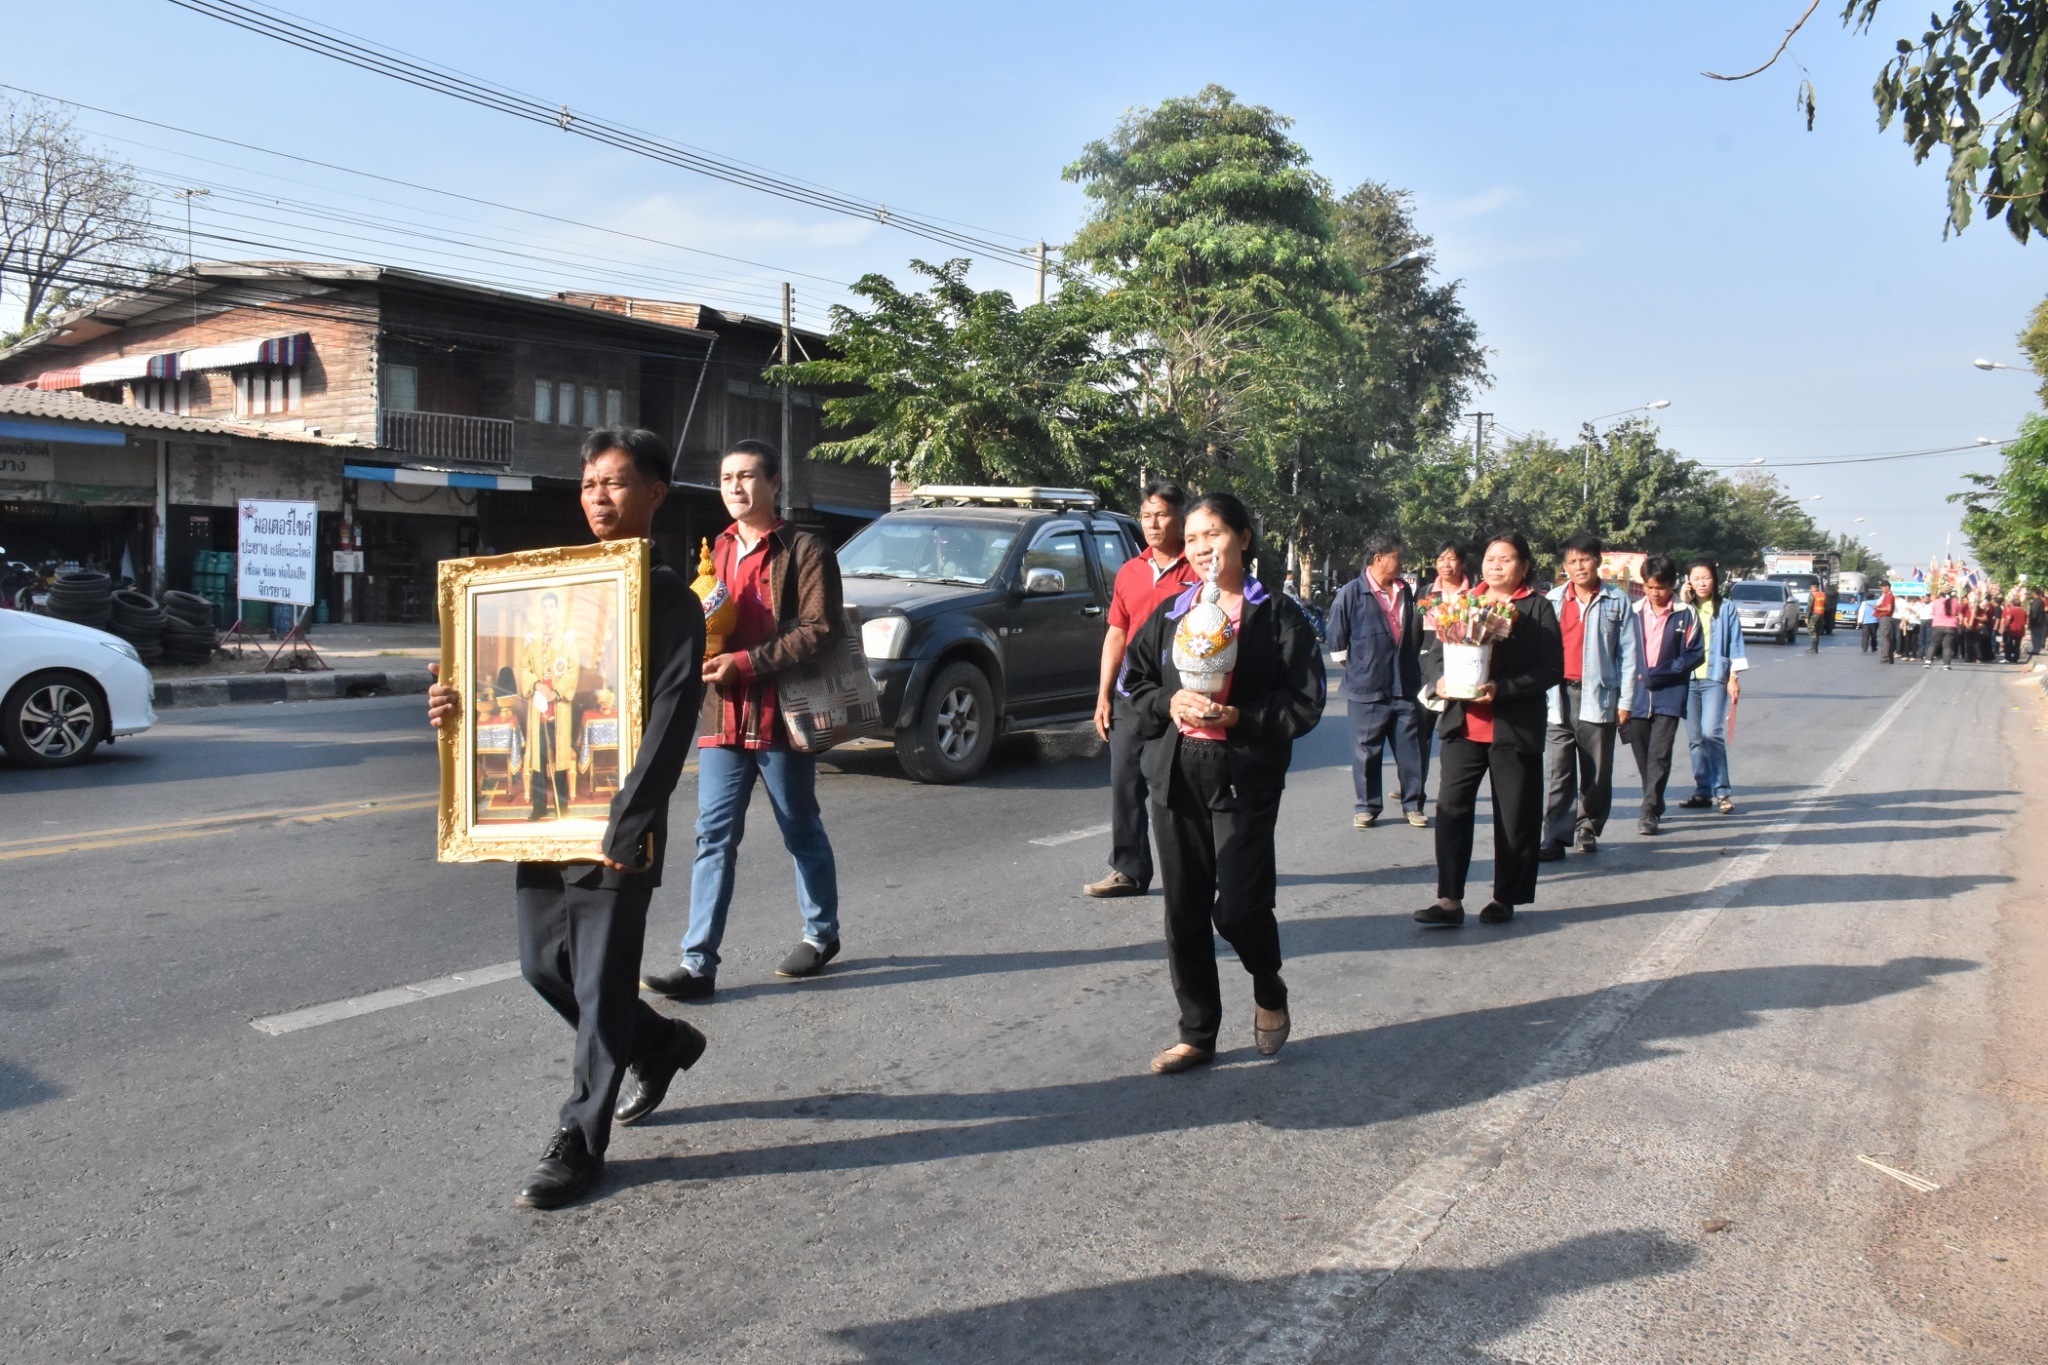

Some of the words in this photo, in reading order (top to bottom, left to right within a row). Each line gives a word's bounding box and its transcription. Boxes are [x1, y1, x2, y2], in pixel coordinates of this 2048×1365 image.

[241, 539, 268, 556] ปะยาง
[258, 580, 291, 598] จักรยาน
